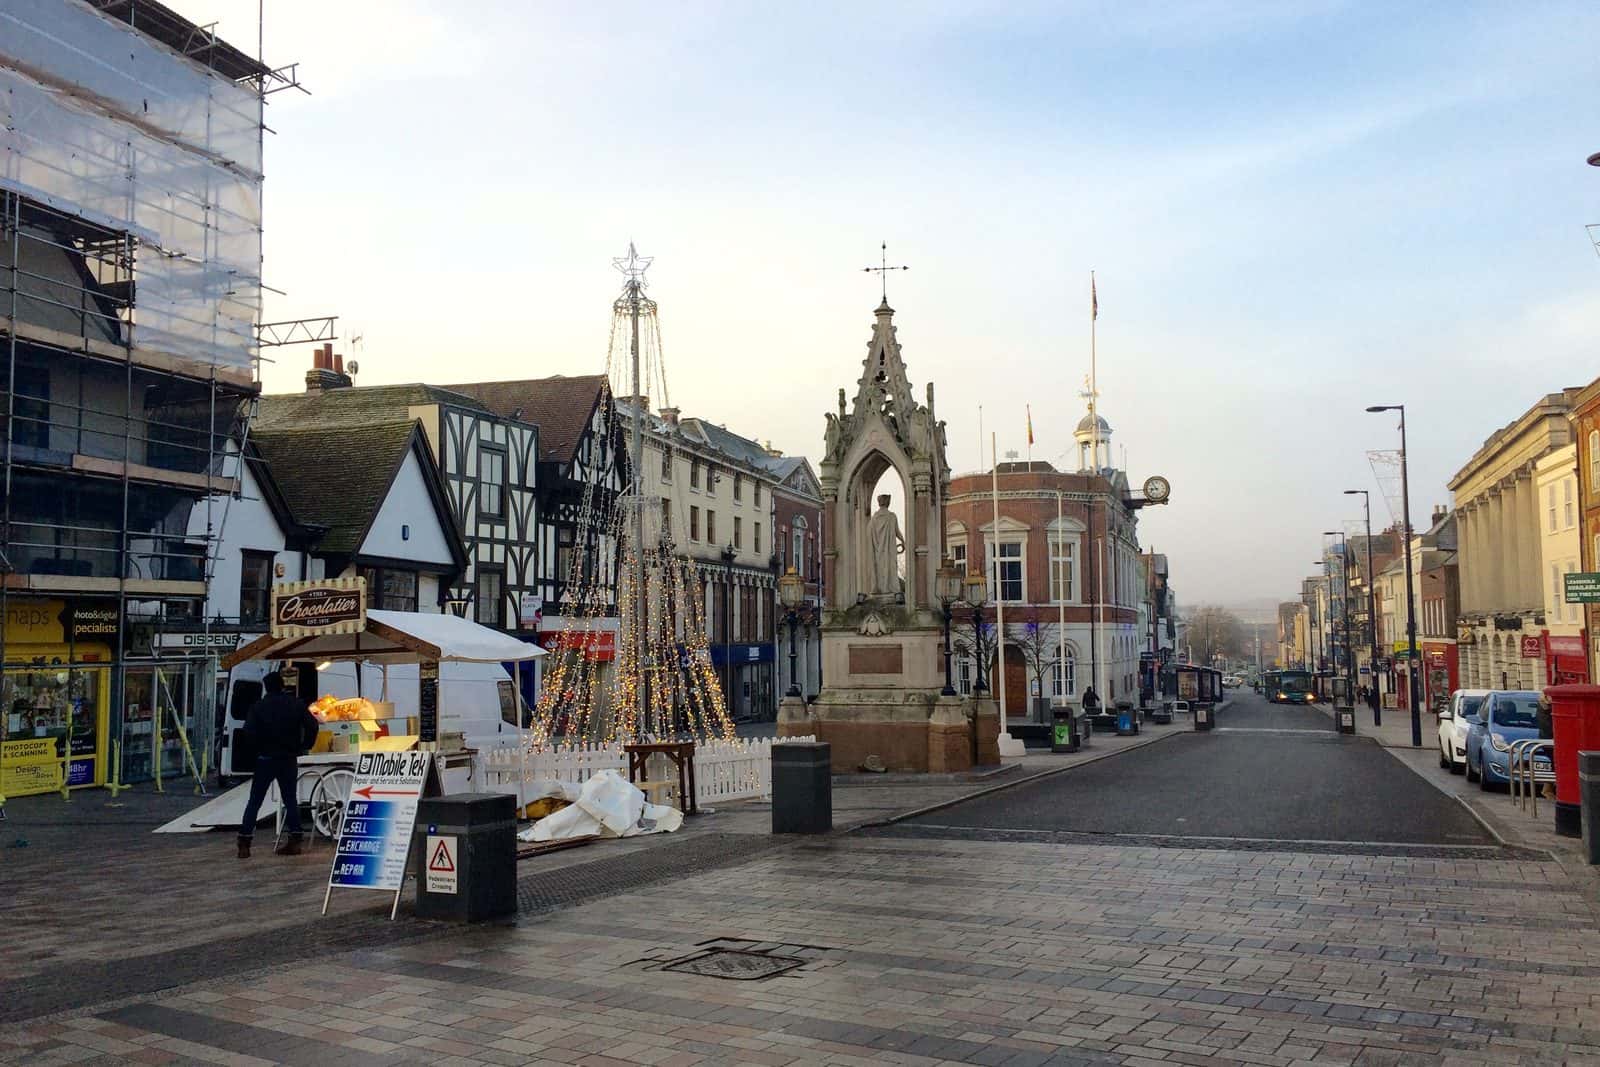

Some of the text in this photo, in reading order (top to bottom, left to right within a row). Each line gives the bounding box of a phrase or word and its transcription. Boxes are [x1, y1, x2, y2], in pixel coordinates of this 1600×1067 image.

[280, 596, 357, 622] Chocolatier
[7, 609, 49, 632] naps
[74, 622, 117, 636] pecialists
[4, 742, 48, 752] PHOTOCOPY
[10, 749, 48, 759] SCANNING
[371, 753, 426, 776] Mobile Tek
[354, 804, 369, 815] BUY
[350, 821, 368, 833] SELL
[345, 840, 381, 853] EXCHANGE
[340, 863, 366, 876] REPAIR
